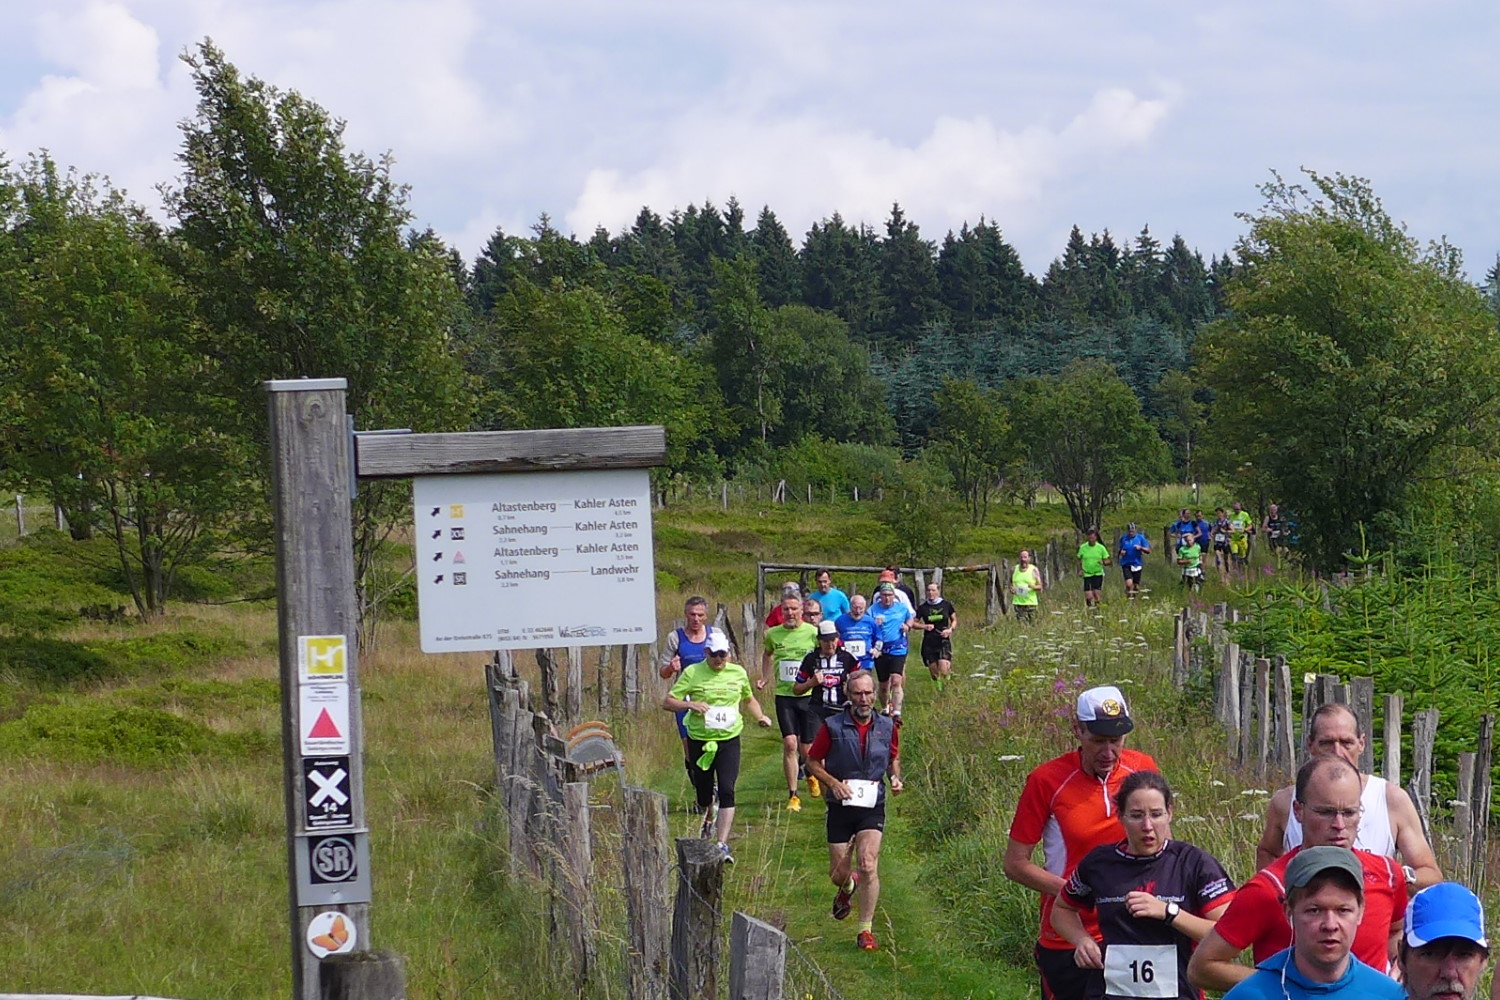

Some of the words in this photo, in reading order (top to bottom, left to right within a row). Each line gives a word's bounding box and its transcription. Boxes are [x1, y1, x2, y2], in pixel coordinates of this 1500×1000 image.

[492, 501, 556, 512] Altastenberg
[574, 498, 606, 508] Kahler
[608, 498, 636, 508] Asten
[493, 524, 547, 535] Sahnehang
[575, 520, 606, 531] Kahler
[610, 520, 638, 530] Asten
[494, 546, 558, 557] Altastenberg
[576, 544, 608, 554] Kahler
[610, 543, 638, 552] Asten
[495, 569, 550, 580] Sahnehang
[591, 564, 639, 576] Landwehr
[716, 712, 726, 722] 44
[322, 802, 338, 812] 14
[319, 846, 349, 872] SR
[1129, 960, 1154, 984] 16
